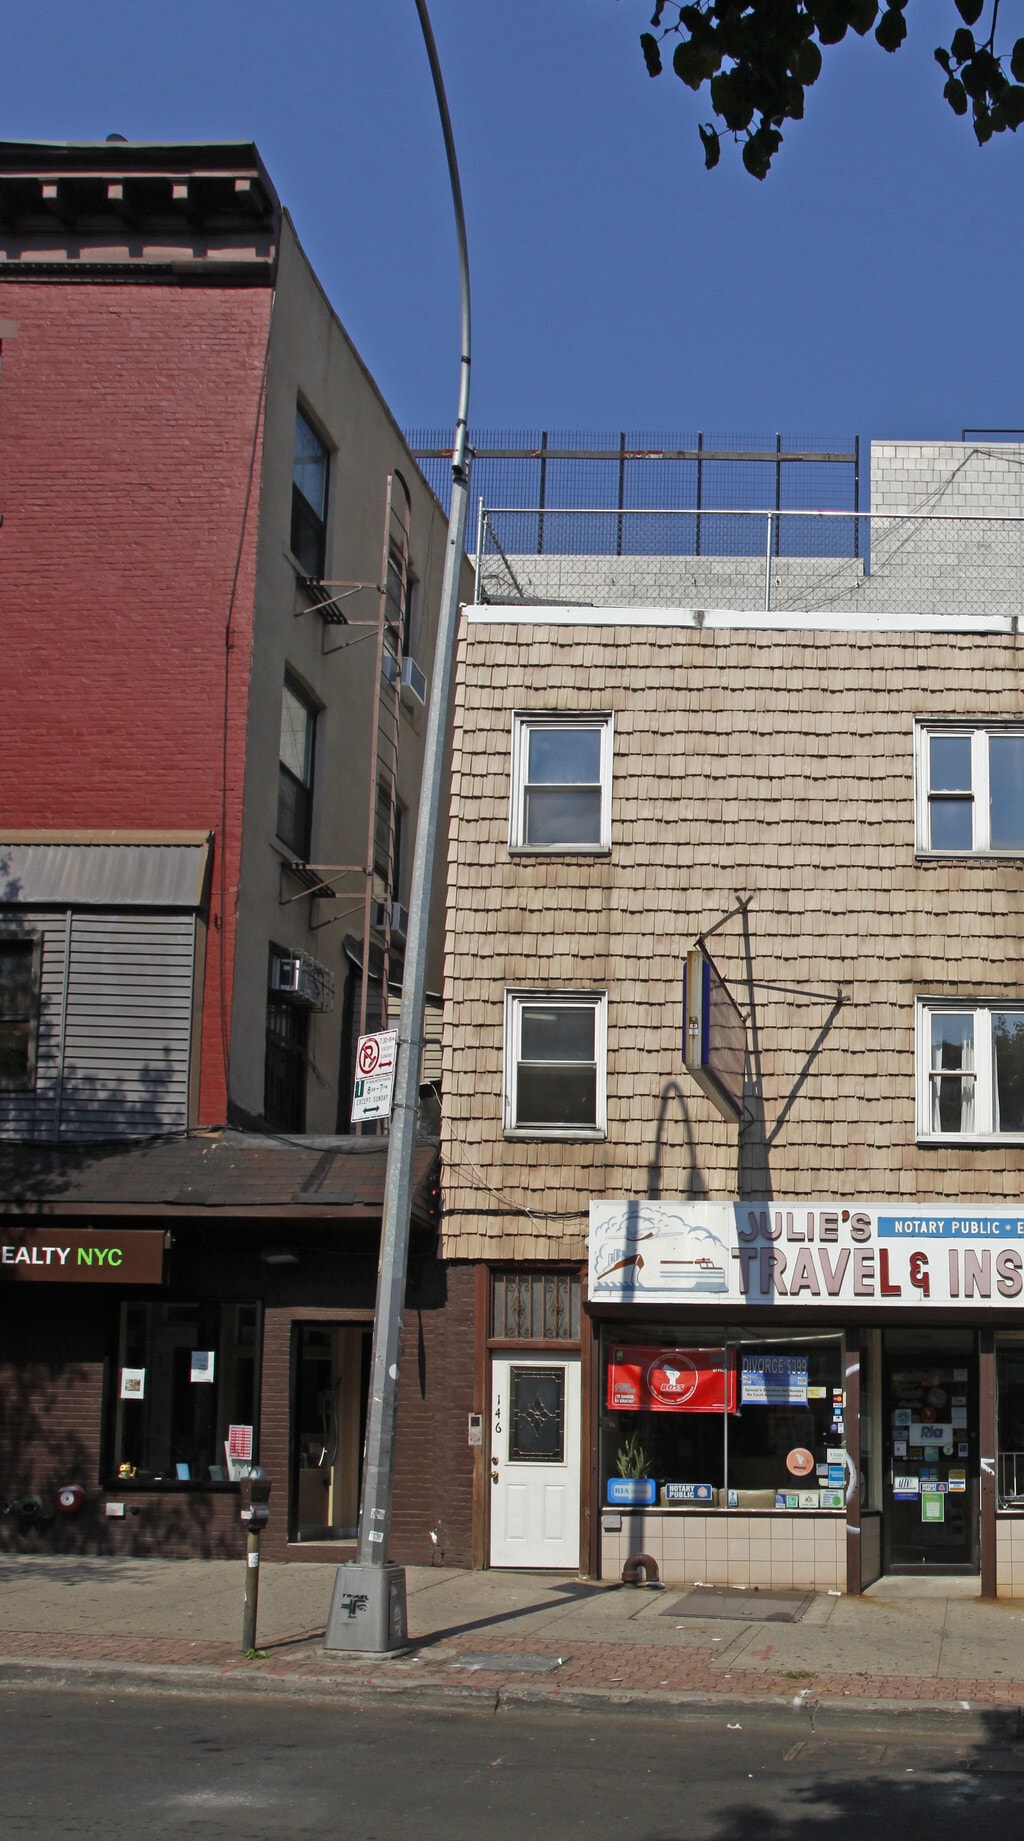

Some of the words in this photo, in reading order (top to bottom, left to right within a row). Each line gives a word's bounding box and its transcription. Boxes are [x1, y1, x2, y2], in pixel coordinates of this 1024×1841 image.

[739, 1210, 872, 1243] JULIE'S
[894, 1220, 945, 1234] NOTARY
[952, 1221, 1000, 1234] PUBLIC
[77, 1247, 123, 1266] NYC
[731, 1247, 902, 1297] TRAVEL
[742, 1358, 784, 1374] DIVORCE
[786, 1359, 807, 1375] $399
[660, 1384, 685, 1392] BOSS
[920, 1425, 944, 1439] Ria
